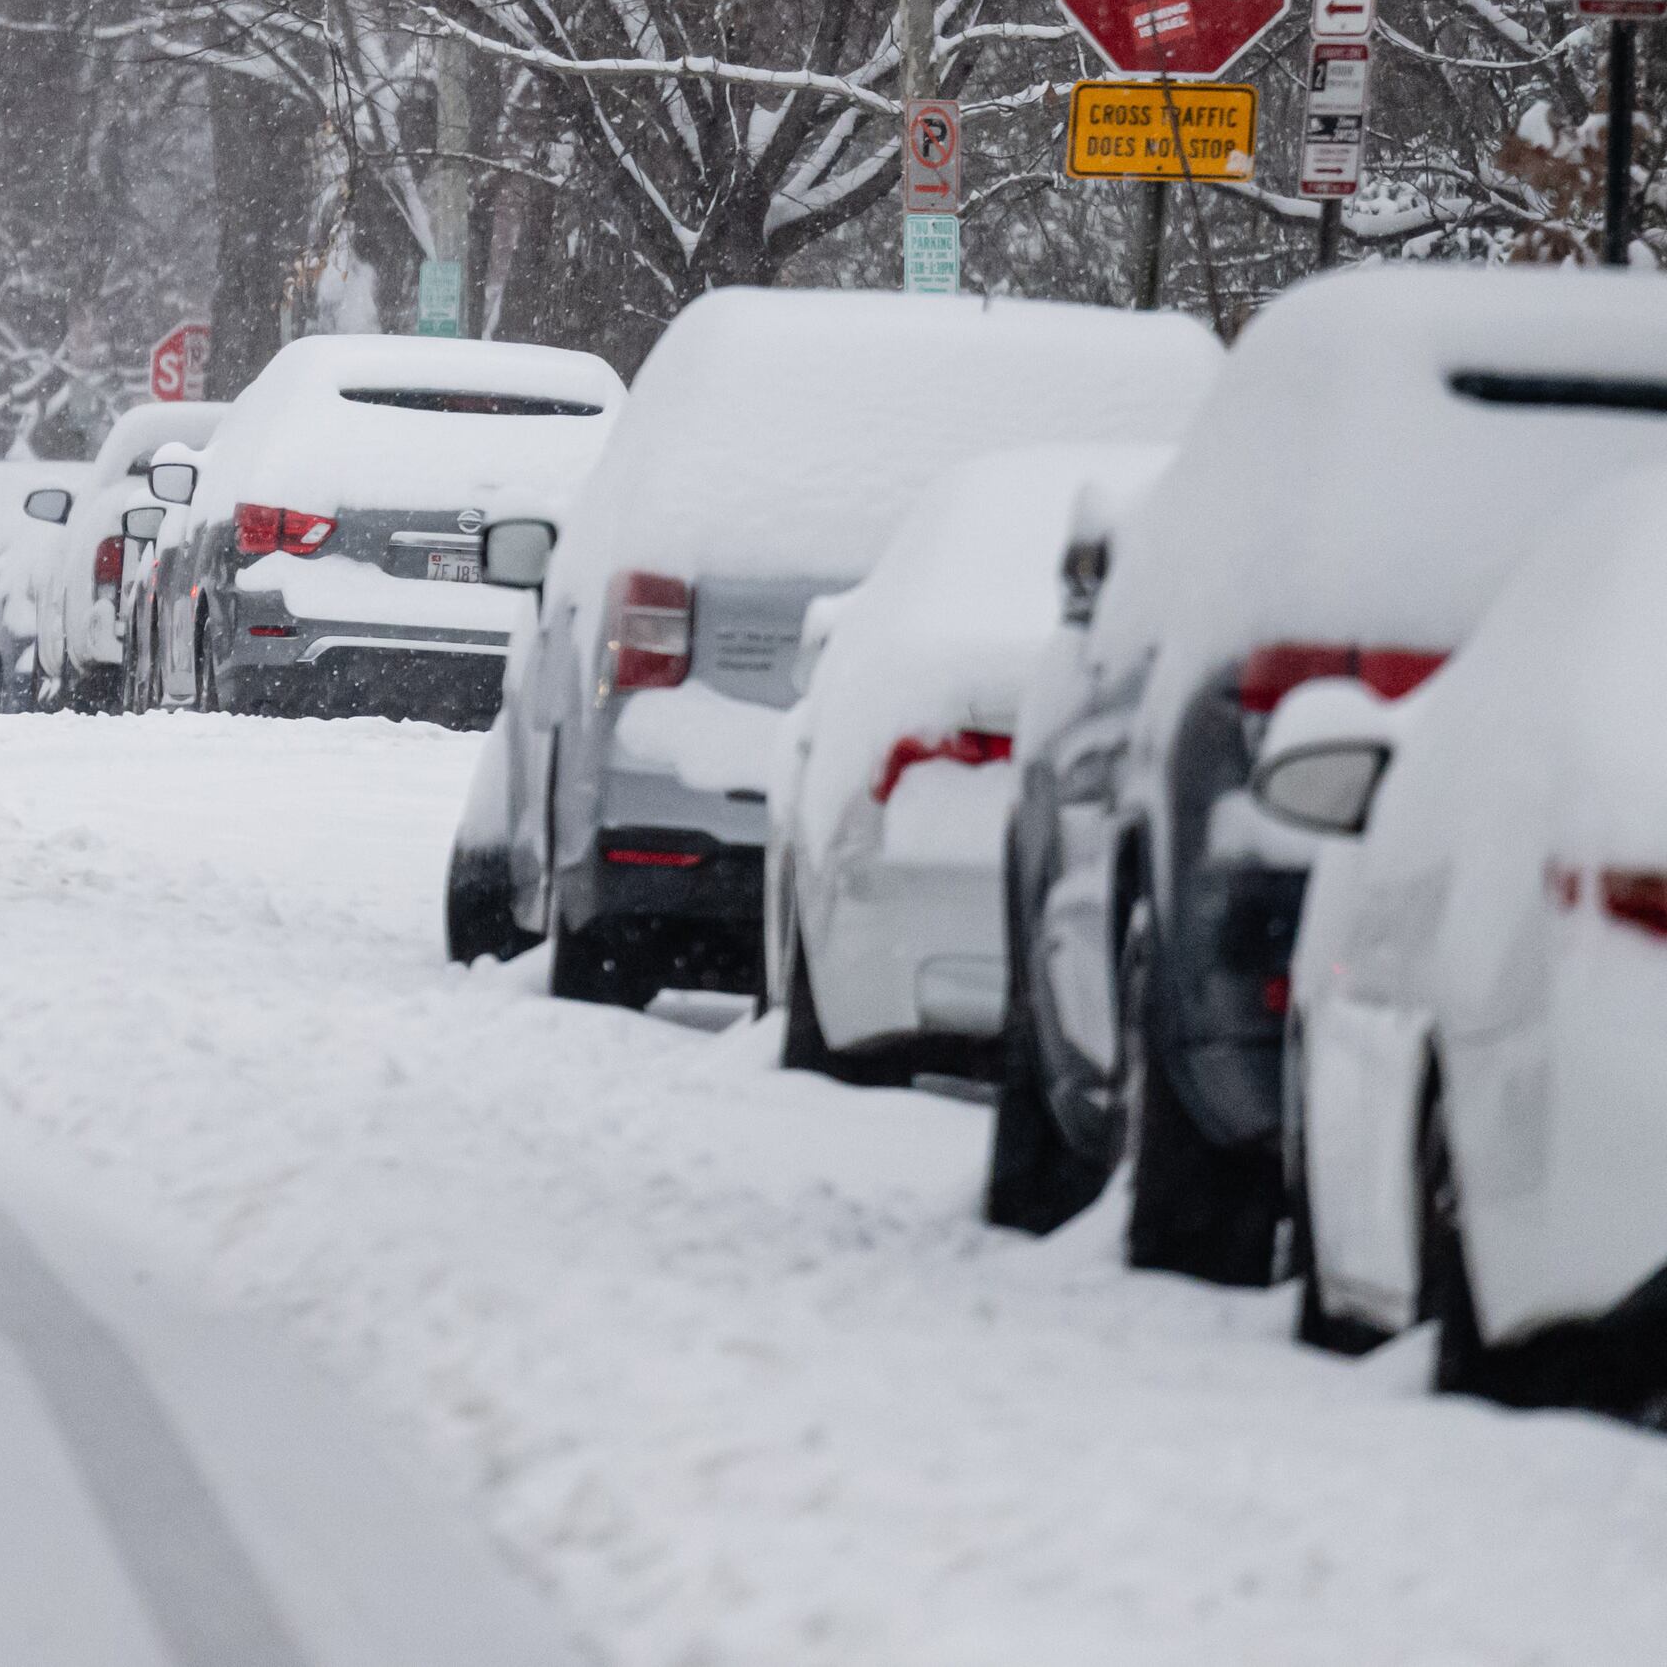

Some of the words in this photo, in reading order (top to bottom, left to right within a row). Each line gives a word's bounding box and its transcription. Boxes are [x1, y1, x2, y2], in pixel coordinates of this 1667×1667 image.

[1089, 103, 1152, 126] CROSS
[1160, 106, 1238, 128] TRAFFIC
[1087, 135, 1136, 157] DOES
[1144, 137, 1181, 158] NOT
[1188, 138, 1236, 159] STOP
[911, 236, 953, 250] PARKING
